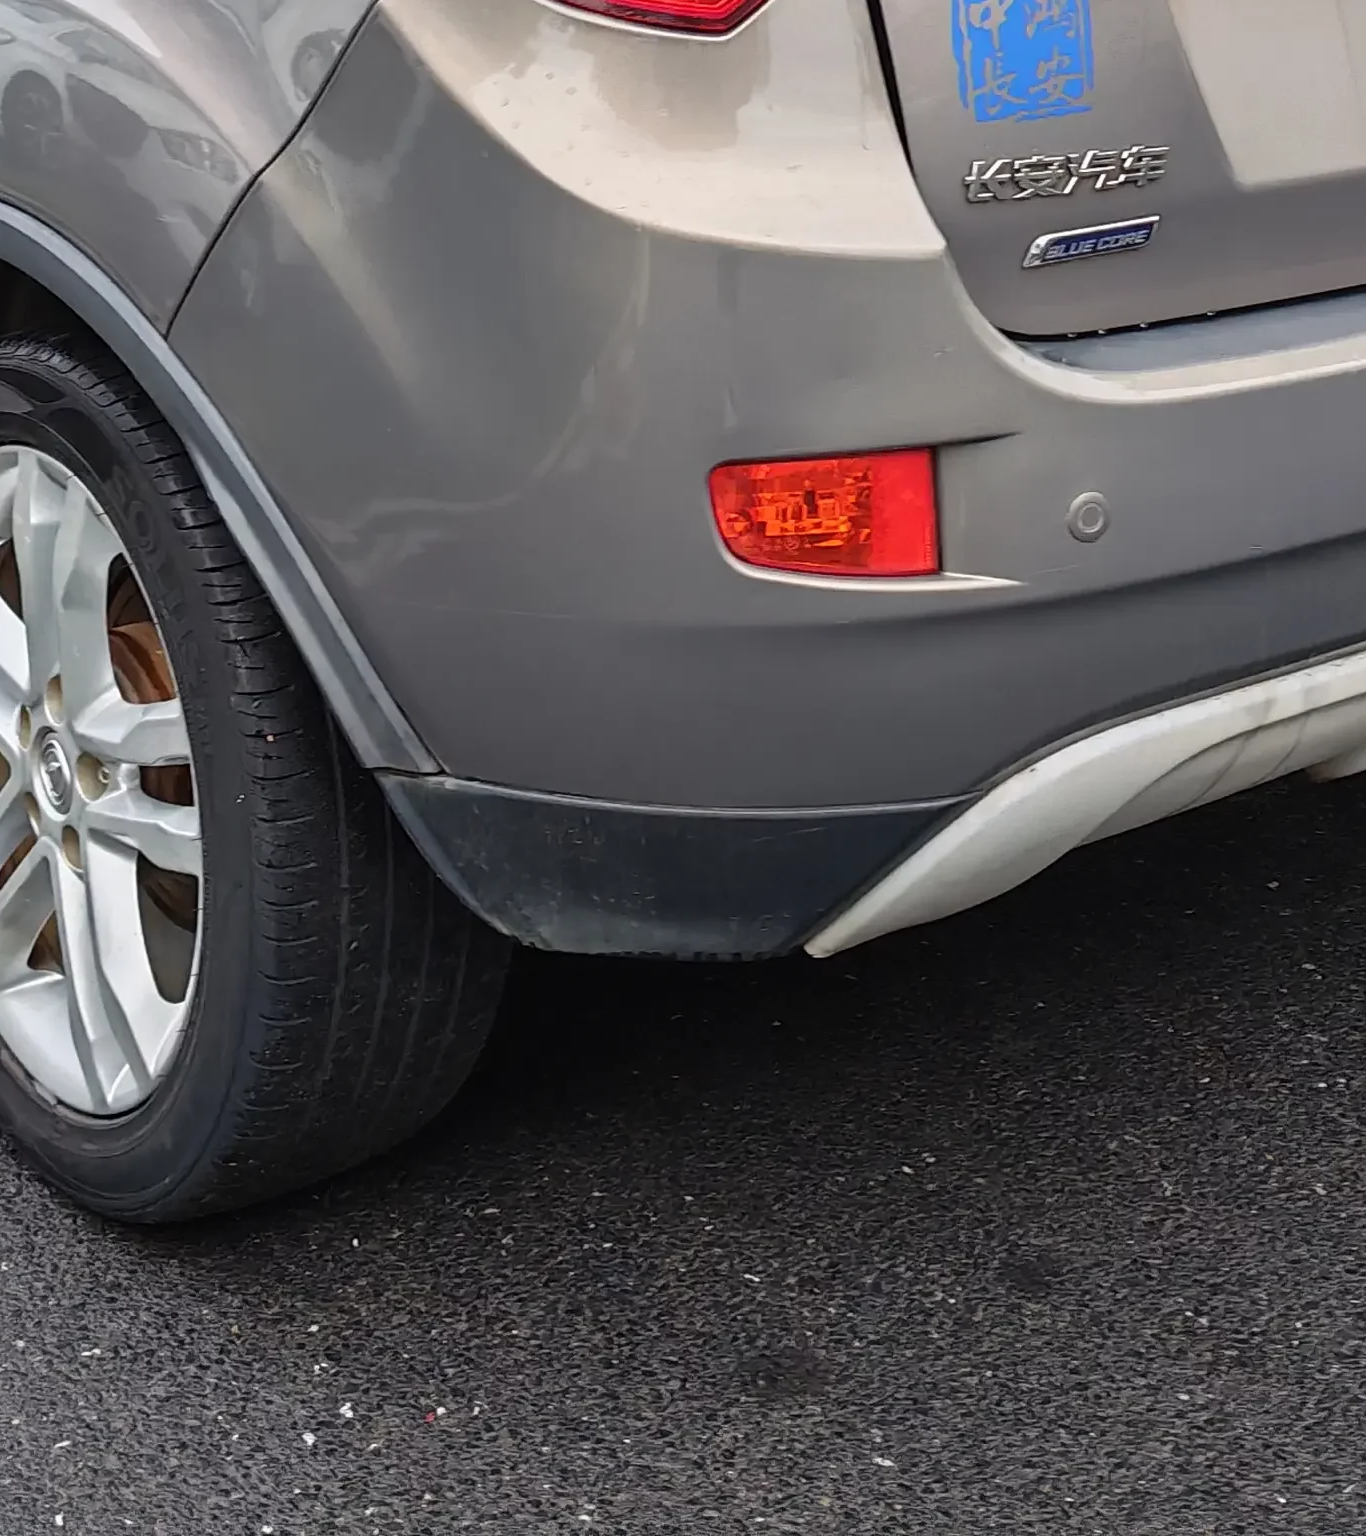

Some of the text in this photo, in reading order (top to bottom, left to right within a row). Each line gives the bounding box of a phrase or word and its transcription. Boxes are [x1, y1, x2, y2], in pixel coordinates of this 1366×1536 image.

[963, 144, 1171, 203] 长安汽车
[1044, 237, 1095, 259] BLUE
